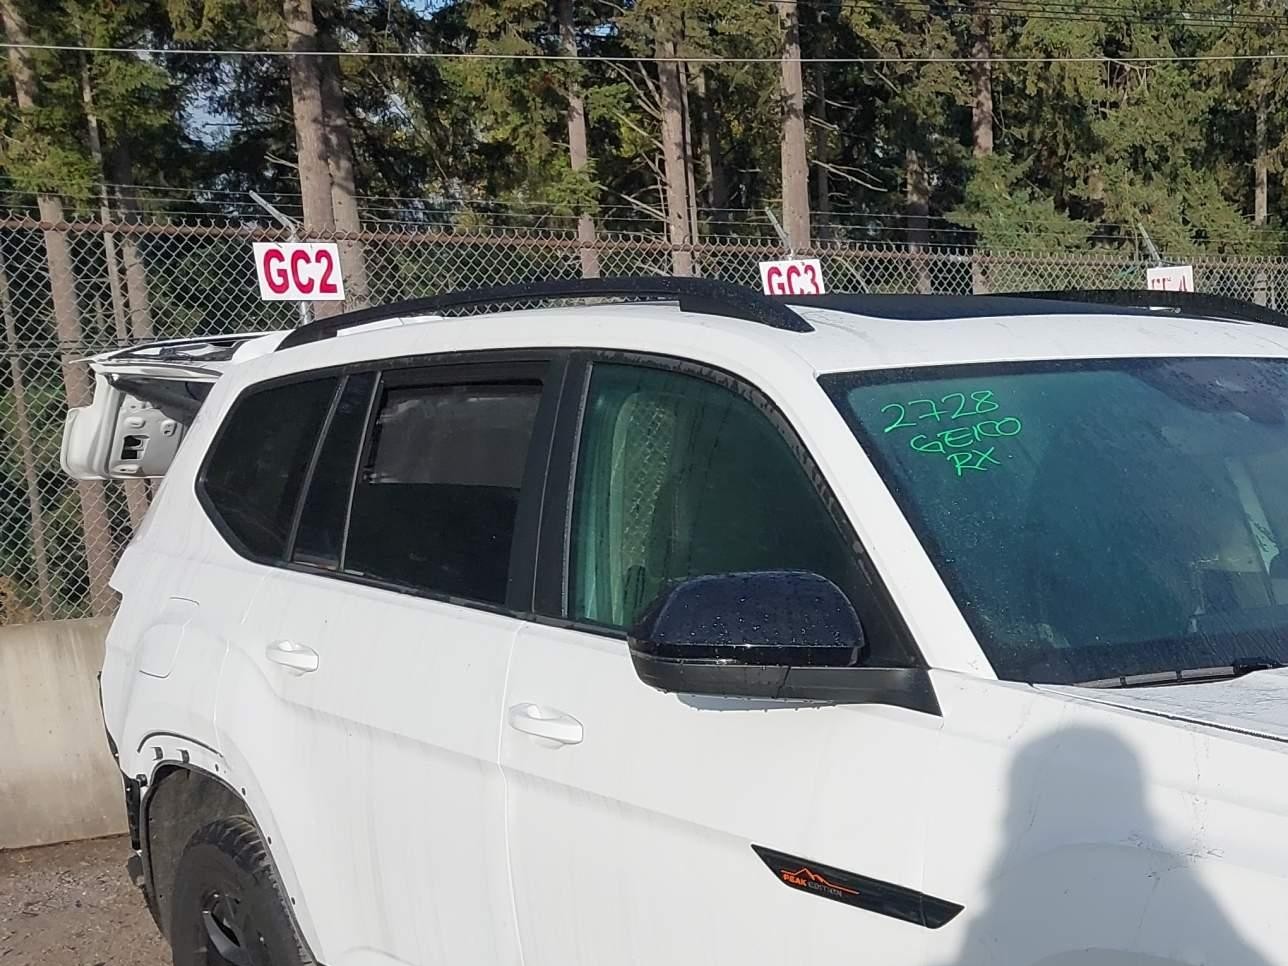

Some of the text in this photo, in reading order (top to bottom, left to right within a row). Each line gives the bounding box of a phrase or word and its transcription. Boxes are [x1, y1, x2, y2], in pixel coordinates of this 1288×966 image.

[263, 249, 338, 294] GC2
[767, 264, 820, 295] GC3
[881, 390, 999, 433] 2728
[910, 417, 1021, 453] GEICO
[946, 446, 1001, 476] RX
[783, 873, 807, 887] PEAK
